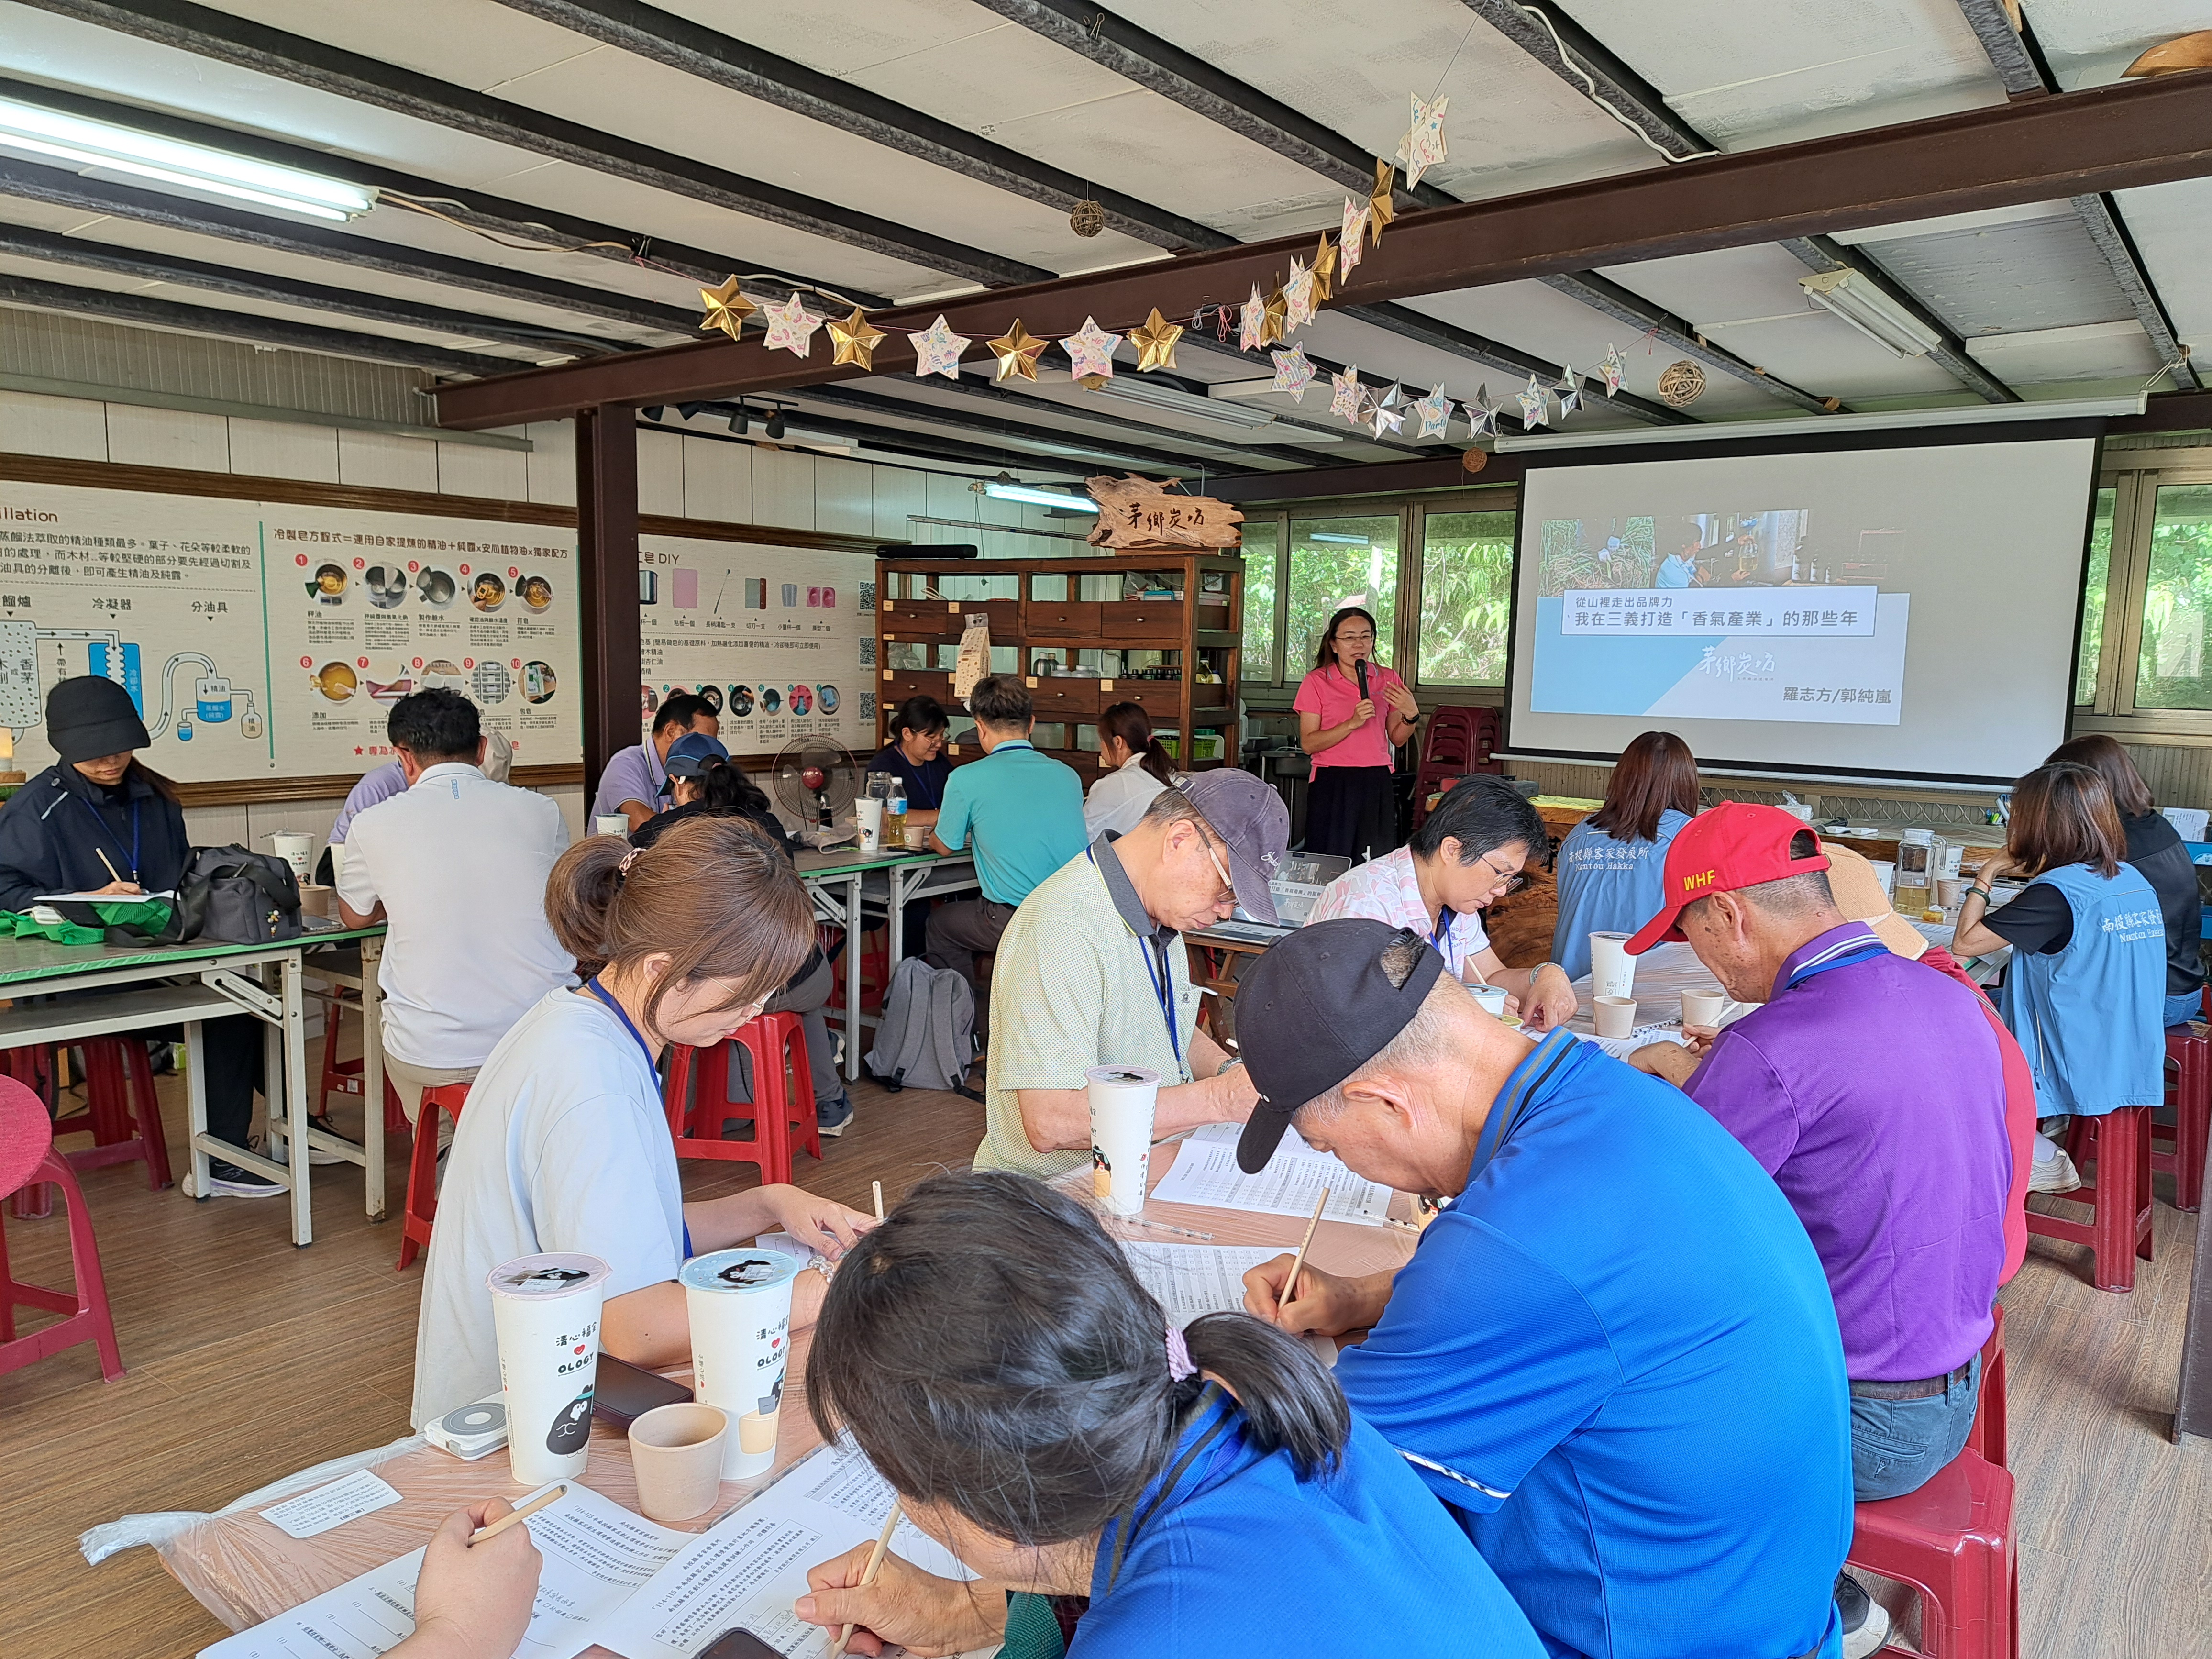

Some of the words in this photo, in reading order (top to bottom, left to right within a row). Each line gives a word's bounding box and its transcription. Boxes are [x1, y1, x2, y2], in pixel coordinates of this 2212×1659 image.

[1128, 502, 1204, 536] 茅鄉炭坊
[659, 553, 680, 565] DIY
[92, 597, 131, 610] 冷凝器
[191, 601, 228, 613] 分油具
[1575, 596, 1673, 608] 從山裡走出品牌力
[1575, 610, 1858, 627] 我在三義打造「香氣產業」的那些年
[1699, 645, 1776, 682] 茅鄉炭坊
[1783, 686, 1891, 704] 羅志方/郭純嵐
[1575, 862, 1604, 872] Nantou
[1606, 862, 1634, 870] Hakka
[1683, 869, 1716, 891] WHF
[558, 1351, 594, 1373] OLOGY
